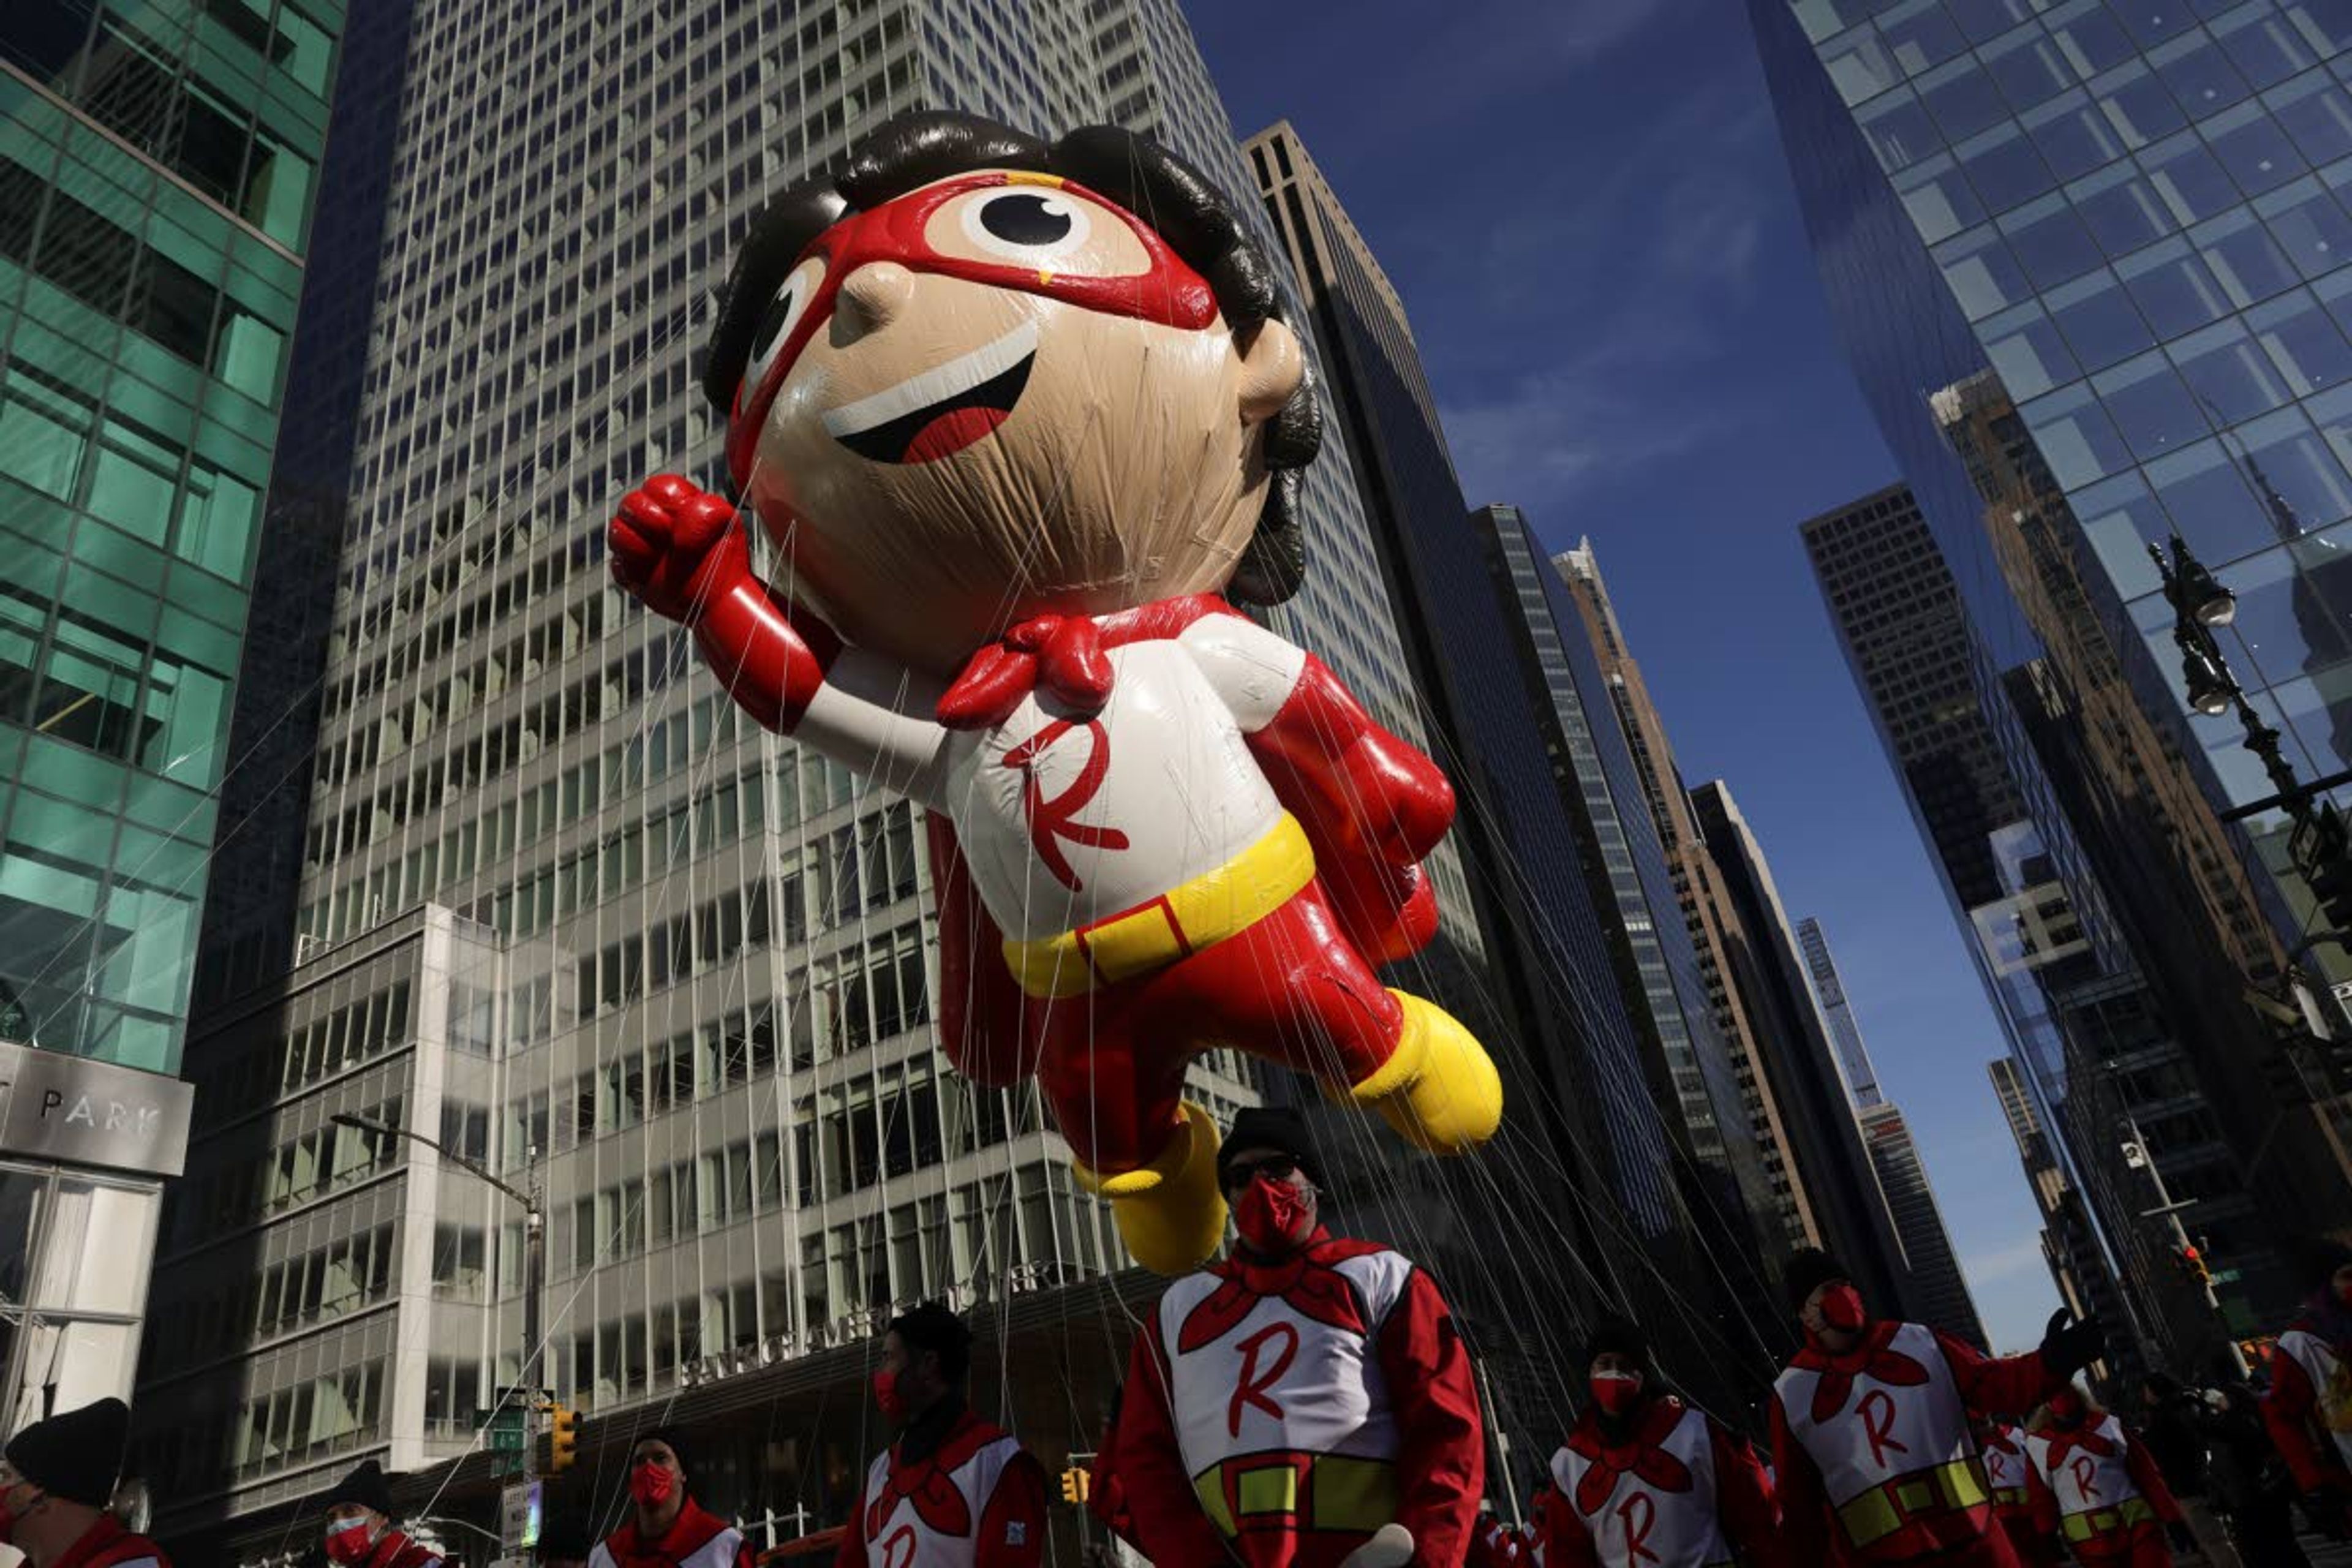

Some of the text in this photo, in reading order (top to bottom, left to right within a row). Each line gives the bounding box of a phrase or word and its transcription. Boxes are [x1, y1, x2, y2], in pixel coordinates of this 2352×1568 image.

[1003, 718, 1130, 893] R
[41, 1090, 161, 1132] PARK
[1229, 1321, 1299, 1438] R
[1855, 1389, 1907, 1468] R
[1988, 1452, 2006, 1482] R
[2070, 1456, 2101, 1504] R
[1617, 1491, 1660, 1568] R
